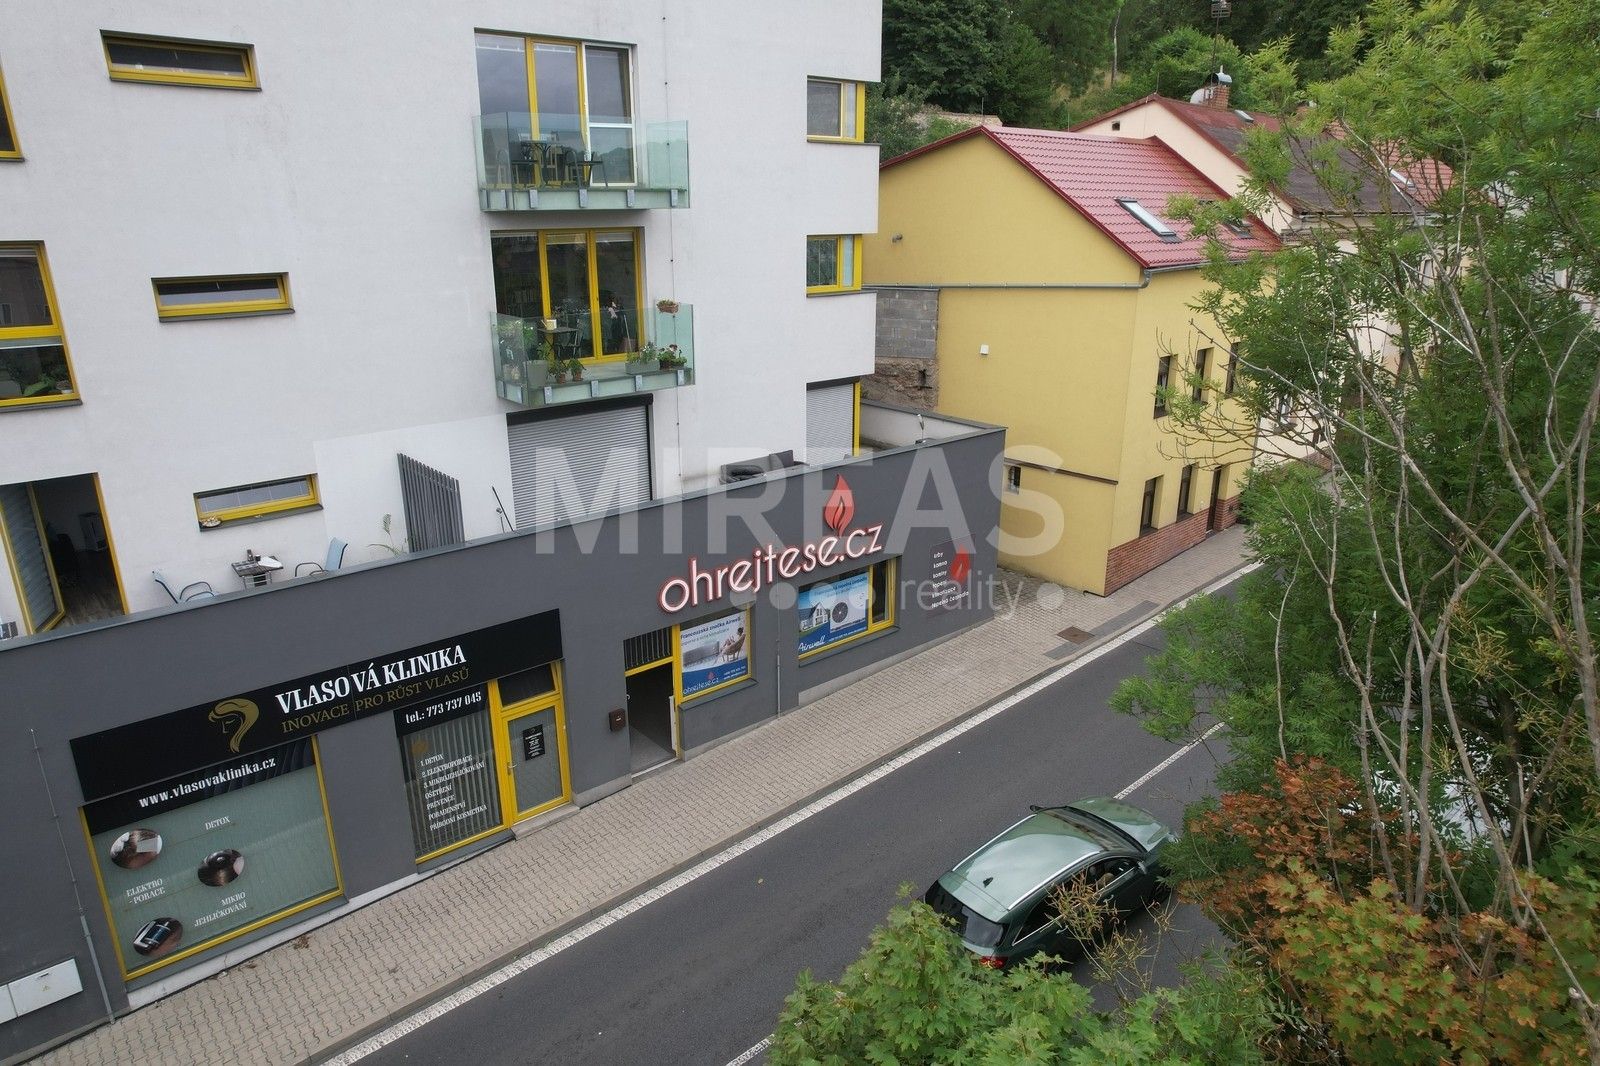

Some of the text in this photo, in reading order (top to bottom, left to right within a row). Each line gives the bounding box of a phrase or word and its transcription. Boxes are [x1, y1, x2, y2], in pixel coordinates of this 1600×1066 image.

[659, 523, 883, 614] ohrejtese.cz
[798, 635, 825, 652] Airwell
[275, 644, 467, 714] VLASOVÁ KLINIKA
[281, 666, 470, 734] INOVACE PRO RŮST VLASŮ
[405, 691, 482, 724] tel.: 773 737 045
[425, 753, 444, 765] DETOX
[426, 754, 473, 776] ELEKTROPORACE
[138, 756, 276, 808] www.vlasovaklinika.cz
[205, 815, 231, 830] DETOX
[126, 878, 163, 897] ELEKTRO
[133, 886, 166, 905] PORACE
[221, 891, 246, 907] MIKRO
[194, 900, 249, 927] JEHLIČKOVÁNÍ
